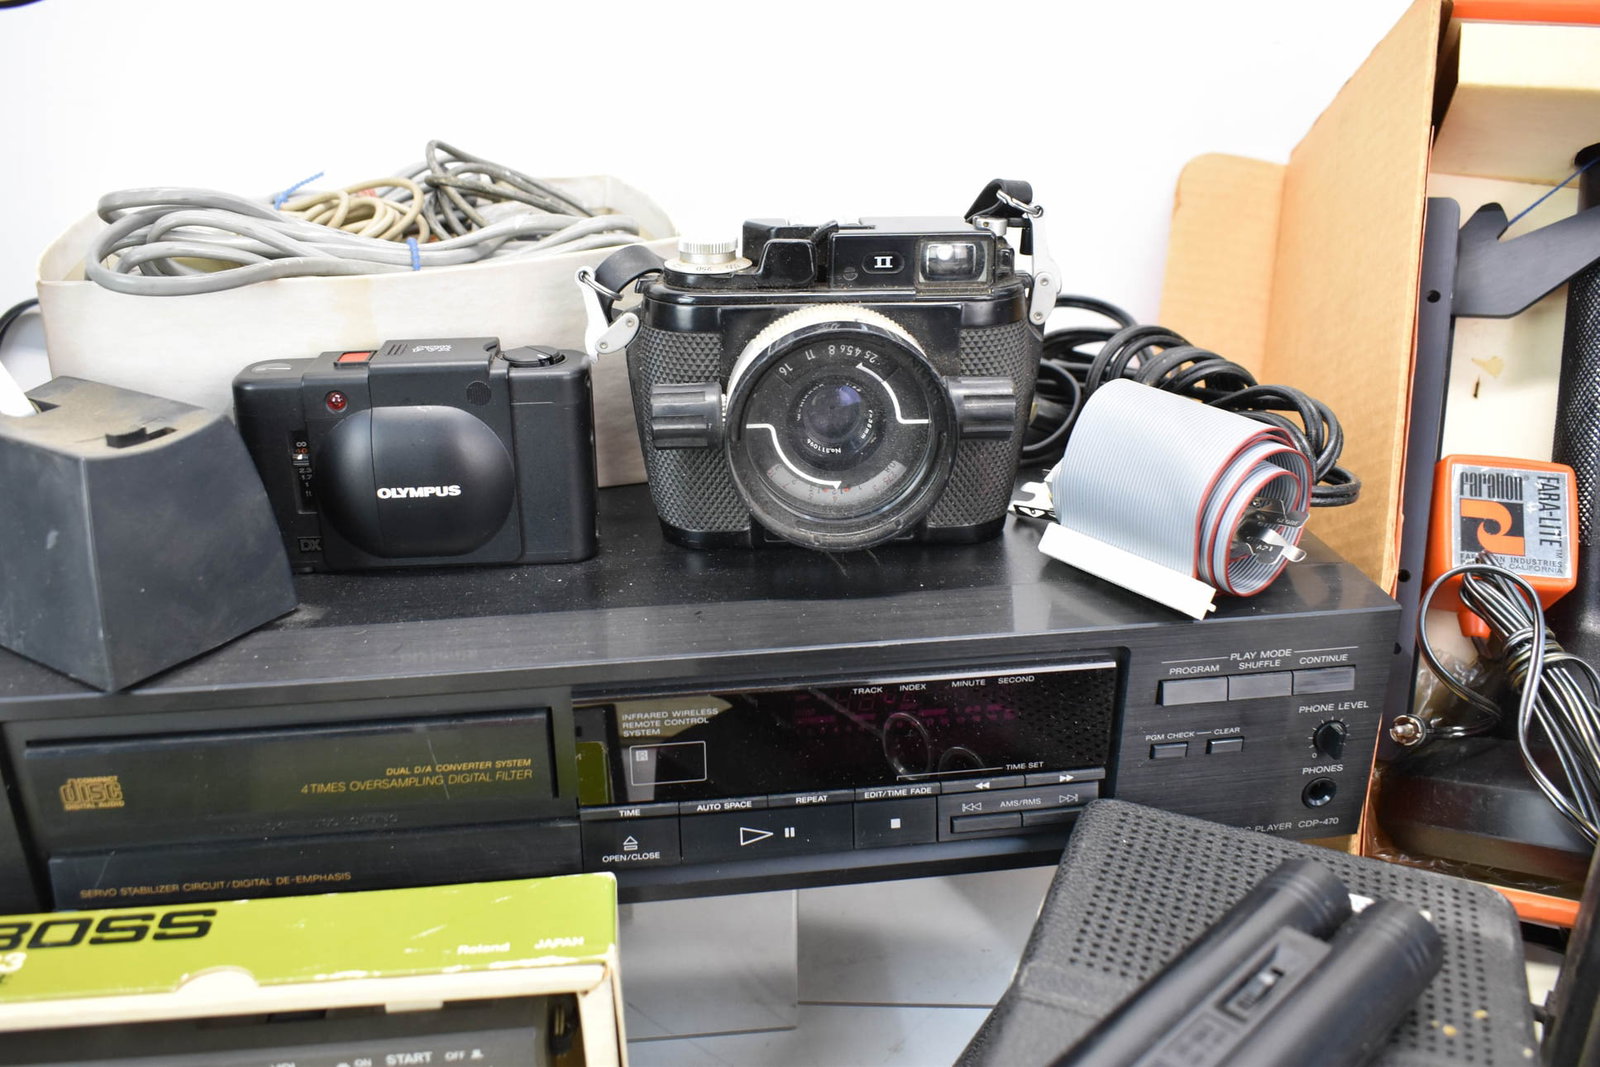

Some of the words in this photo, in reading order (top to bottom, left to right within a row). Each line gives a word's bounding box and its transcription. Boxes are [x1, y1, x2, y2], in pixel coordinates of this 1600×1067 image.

[805, 349, 816, 360] 11
[828, 344, 836, 355] 8
[778, 363, 793, 376] 16
[376, 485, 462, 499] OLYMPUS
[300, 539, 322, 551] DX
[1510, 557, 1563, 567] INDUSTRIES
[1508, 563, 1564, 574] CALIFORNIA
[1230, 652, 1257, 661] PLAY
[1260, 649, 1292, 659] MODE
[1299, 654, 1348, 665] CONTINUE
[1169, 664, 1220, 675] PROGRAM
[1238, 659, 1281, 670] SHUFFLE
[951, 679, 986, 688] MINUTE
[997, 675, 1035, 685] SECOND
[852, 686, 883, 695] TRACK
[900, 683, 926, 692] INDEX
[1298, 703, 1335, 714] PHONE
[1338, 700, 1369, 711] LEVEL
[622, 711, 668, 721] INFRARED
[672, 708, 719, 717] WIRELESS
[622, 719, 661, 729] REMOTE
[664, 717, 709, 726] CONTROL
[623, 728, 661, 737] SYSTEM
[1145, 733, 1165, 742] PGM
[1167, 731, 1195, 739] CHECK
[1213, 727, 1240, 735] CLEAR
[386, 766, 410, 776] DUAL
[414, 765, 432, 774] D/A
[435, 760, 492, 773] CONVERTER
[495, 758, 532, 768] SYSTEM
[1005, 762, 1025, 771] TIME
[1029, 761, 1044, 769] SET
[1302, 764, 1343, 775] PHONES
[350, 775, 444, 792] OVERSAMPLING
[448, 772, 492, 785] DIGITAL
[496, 769, 533, 782] FILTER
[59, 777, 123, 802] disc
[864, 787, 907, 799] EDIT/TIME
[910, 786, 932, 796] FADE
[795, 794, 828, 804] REPEAT
[1000, 796, 1042, 808] AMS/RMS
[697, 802, 722, 812] AUTO
[724, 800, 752, 810] SPACE
[619, 808, 641, 817] TIME
[1255, 821, 1292, 833] PLAYER
[1298, 817, 1339, 828] CDP-470
[602, 851, 661, 863] OPEN/CLOSE
[80, 888, 117, 899] SERVO
[120, 884, 179, 897] STABILIZER
[276, 871, 351, 887] DE-EMPHASIS
[457, 942, 511, 955] Roland
[533, 936, 585, 949] JAPAN
[385, 1051, 433, 1066] START
[444, 1050, 465, 1062] OFF
